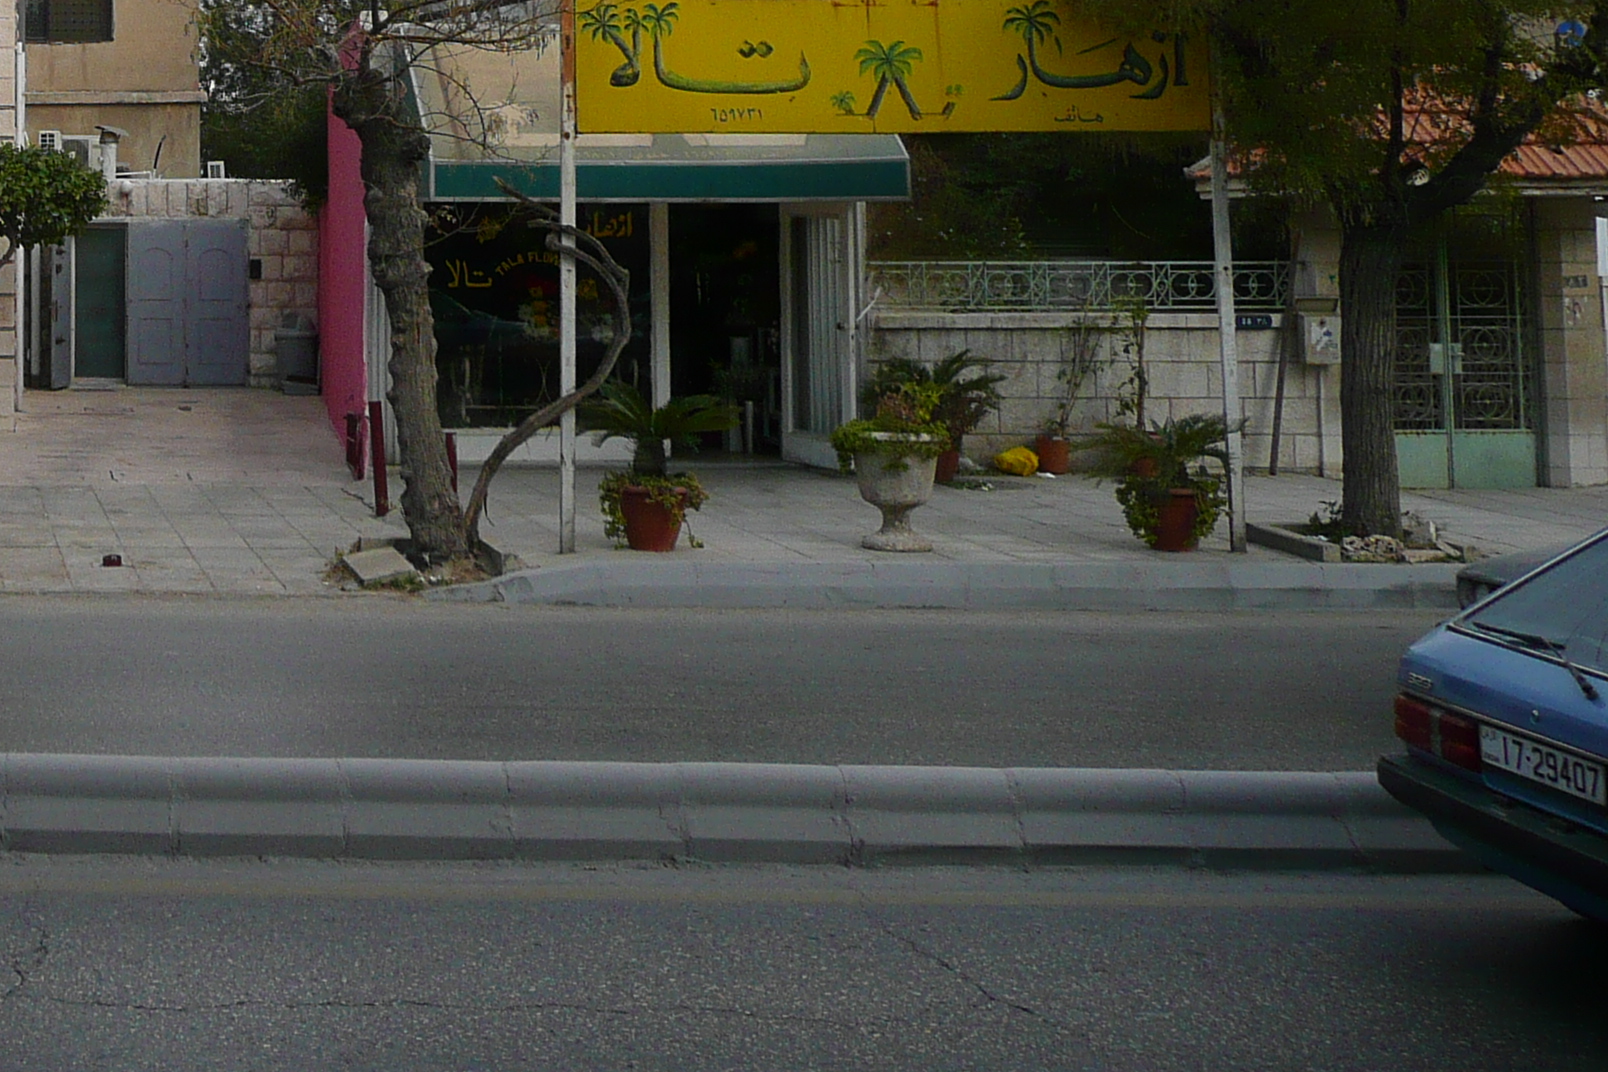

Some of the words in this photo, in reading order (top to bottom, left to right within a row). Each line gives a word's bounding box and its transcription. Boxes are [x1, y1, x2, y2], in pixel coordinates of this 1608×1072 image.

[579, 3, 812, 94] تالا
[445, 259, 493, 288] تالا
[495, 253, 525, 276] TALA
